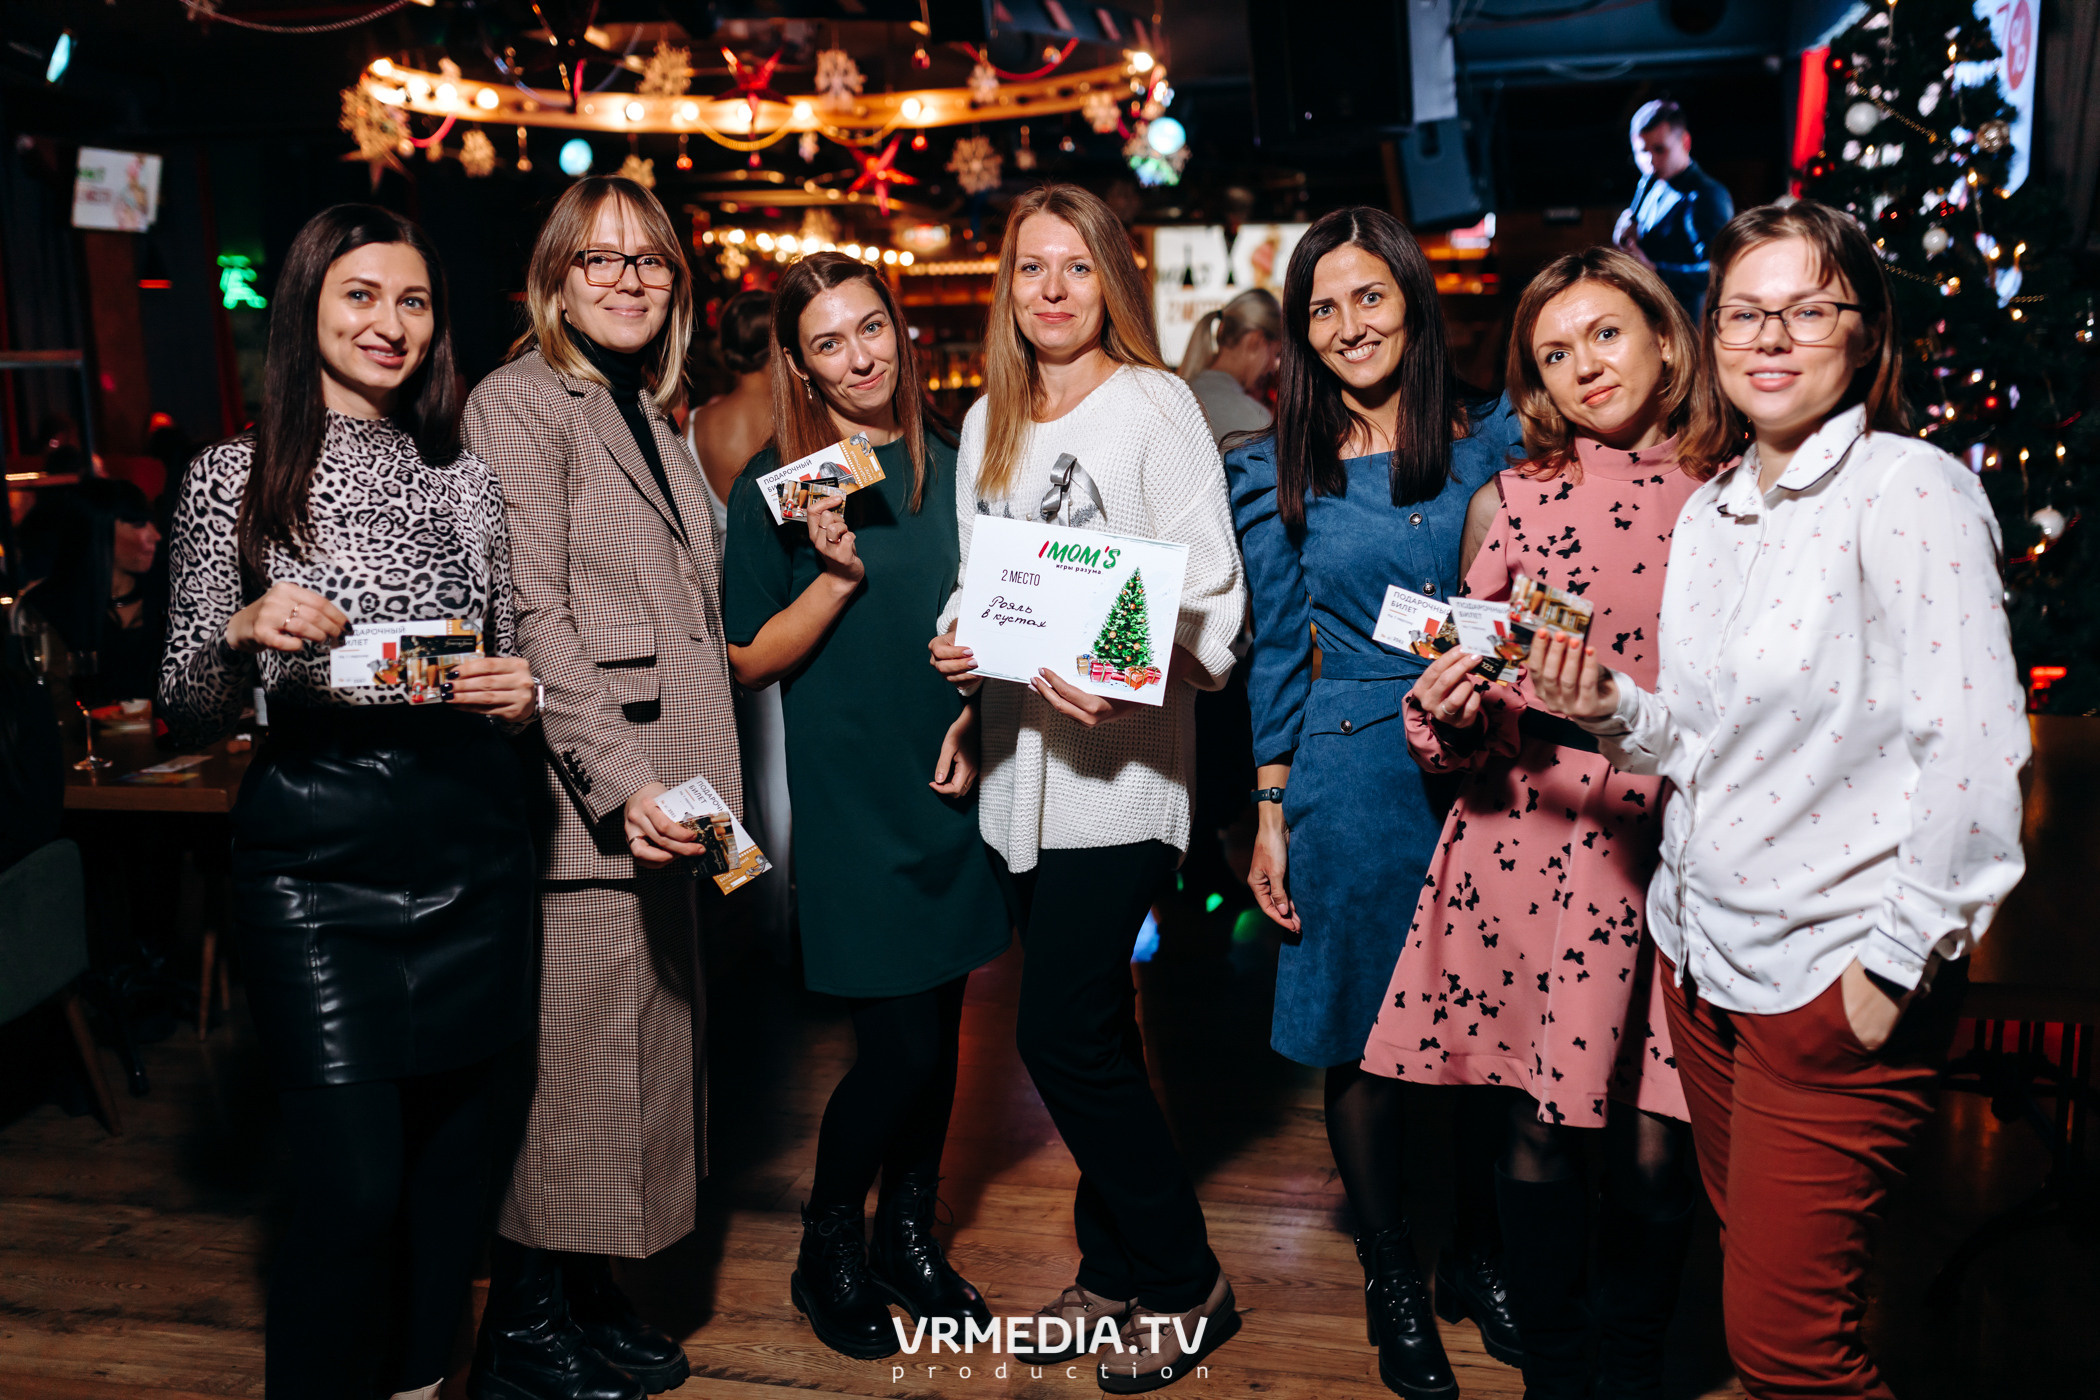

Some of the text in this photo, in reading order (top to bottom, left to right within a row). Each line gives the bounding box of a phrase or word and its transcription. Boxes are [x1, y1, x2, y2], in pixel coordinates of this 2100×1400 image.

[764, 459, 812, 485] ПОДАРОЧНЫЙ
[1001, 569, 1041, 587] 2 МЕСТО
[1075, 566, 1102, 575] разума
[988, 595, 1033, 614] Рояль
[1390, 600, 1417, 614] БИЛЕТ
[993, 613, 1047, 628] кустах
[353, 626, 406, 636] ДАРОЧНЫЙ
[345, 638, 369, 647] ИЛЕТ
[688, 784, 707, 804] БИЛЕТ
[696, 780, 724, 812] ПОДАРОЧ
